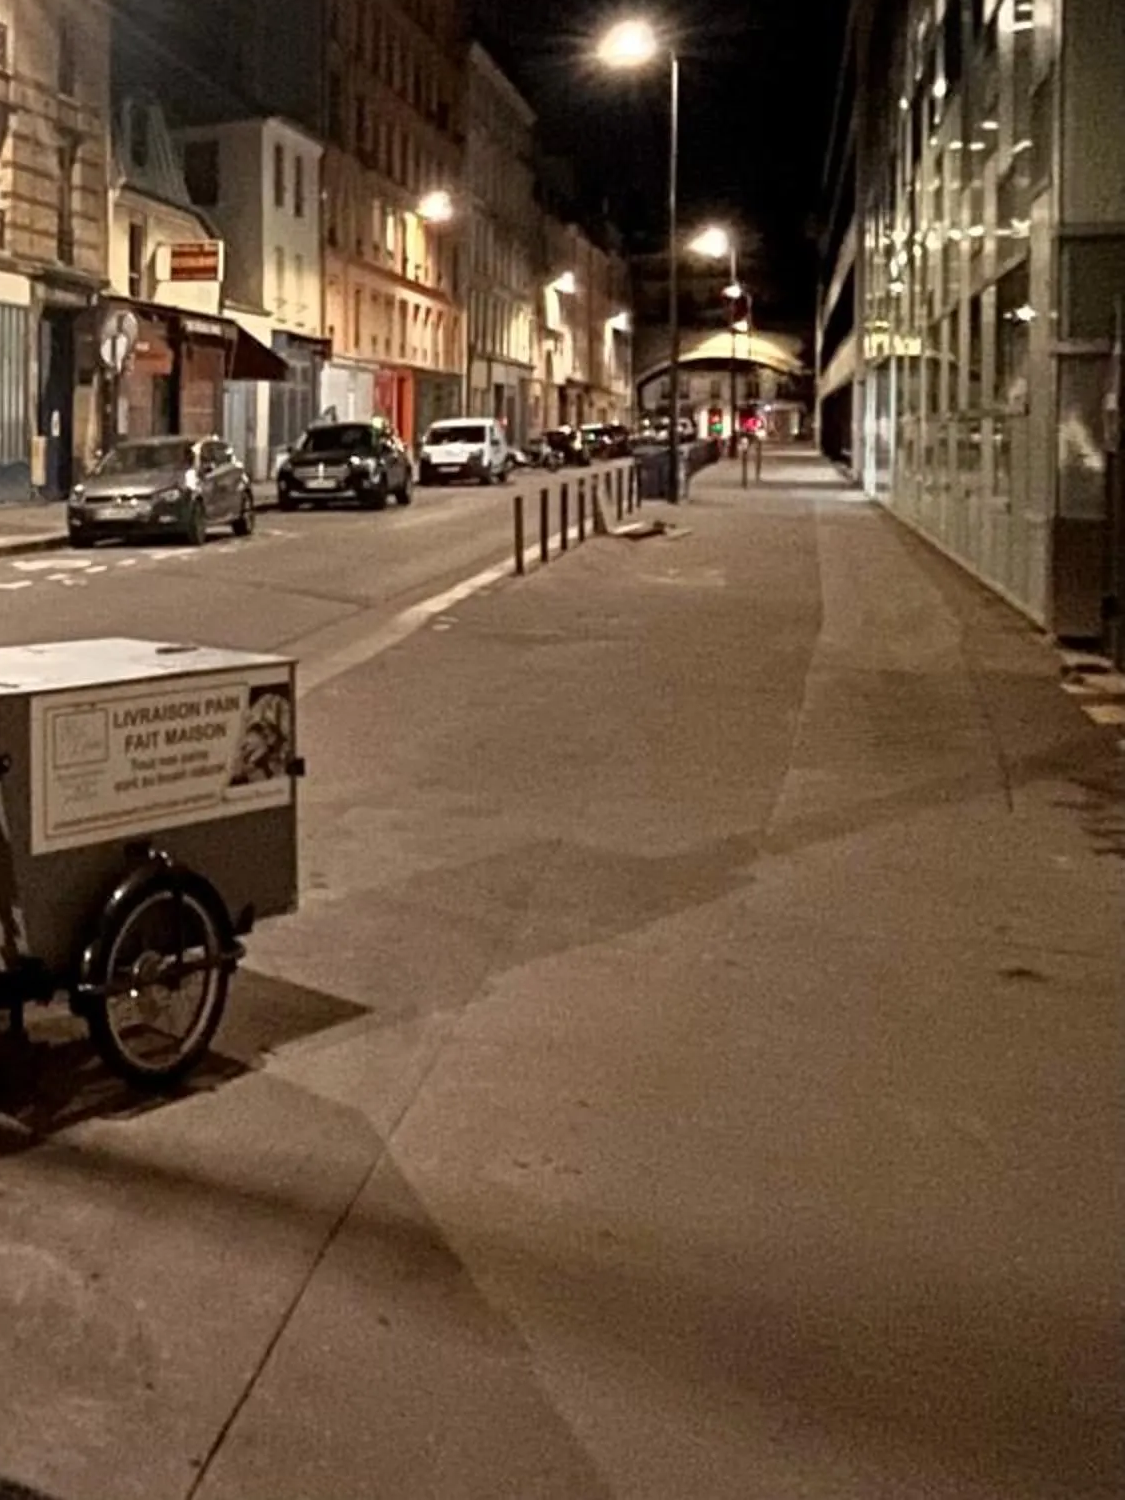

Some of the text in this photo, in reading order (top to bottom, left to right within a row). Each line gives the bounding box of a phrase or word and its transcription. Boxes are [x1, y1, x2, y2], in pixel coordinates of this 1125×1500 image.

[113, 695, 240, 729] LIVRAISON PAIN
[125, 722, 227, 753] FAIT MAISON
